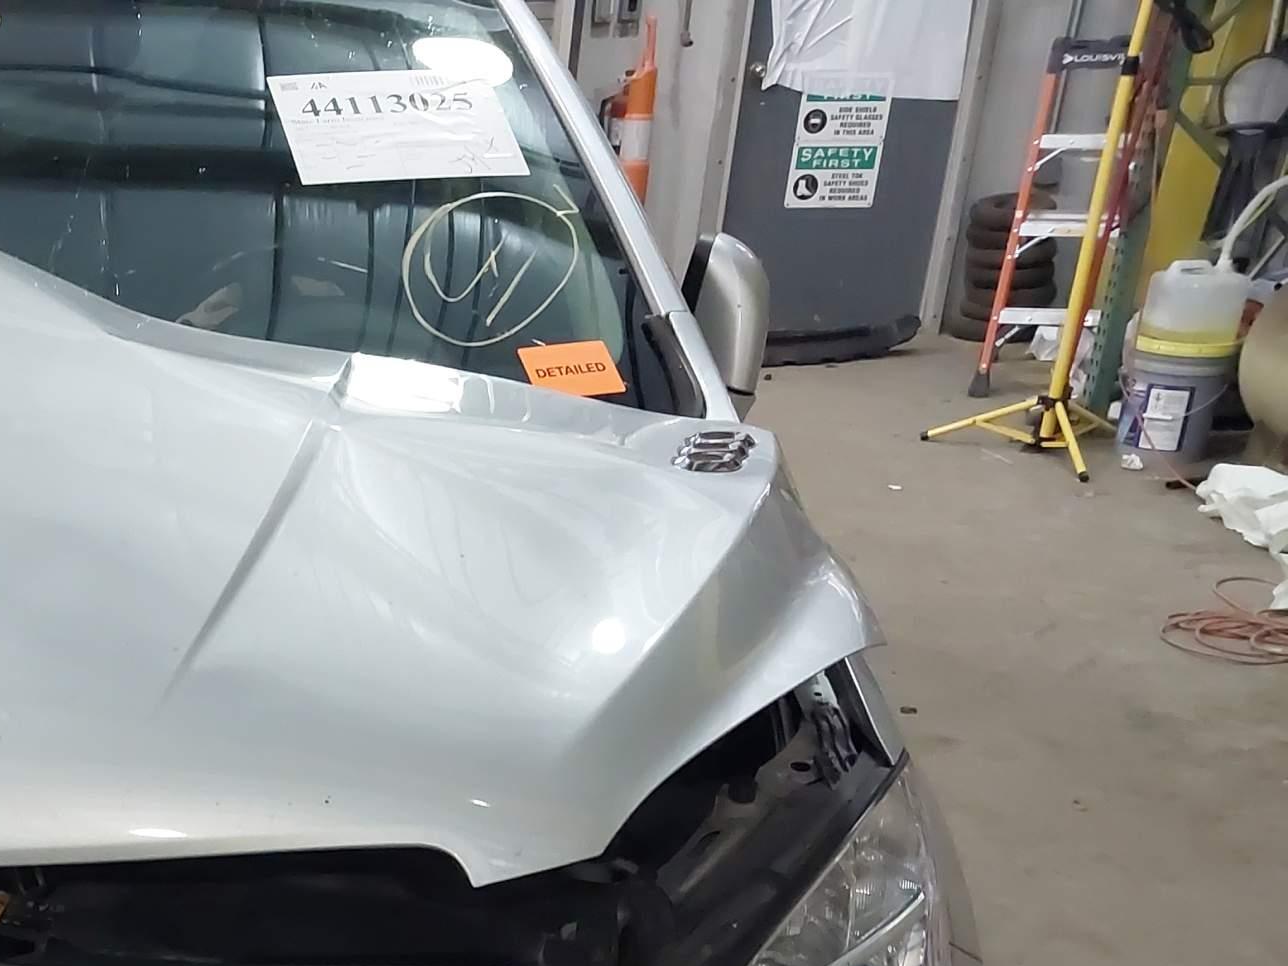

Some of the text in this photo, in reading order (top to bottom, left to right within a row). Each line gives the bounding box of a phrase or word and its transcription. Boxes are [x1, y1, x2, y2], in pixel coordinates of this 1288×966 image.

[302, 92, 473, 117] 44113025
[800, 147, 873, 162] SAFETY
[812, 159, 861, 168] FIRST
[536, 361, 606, 379] DETAILED
